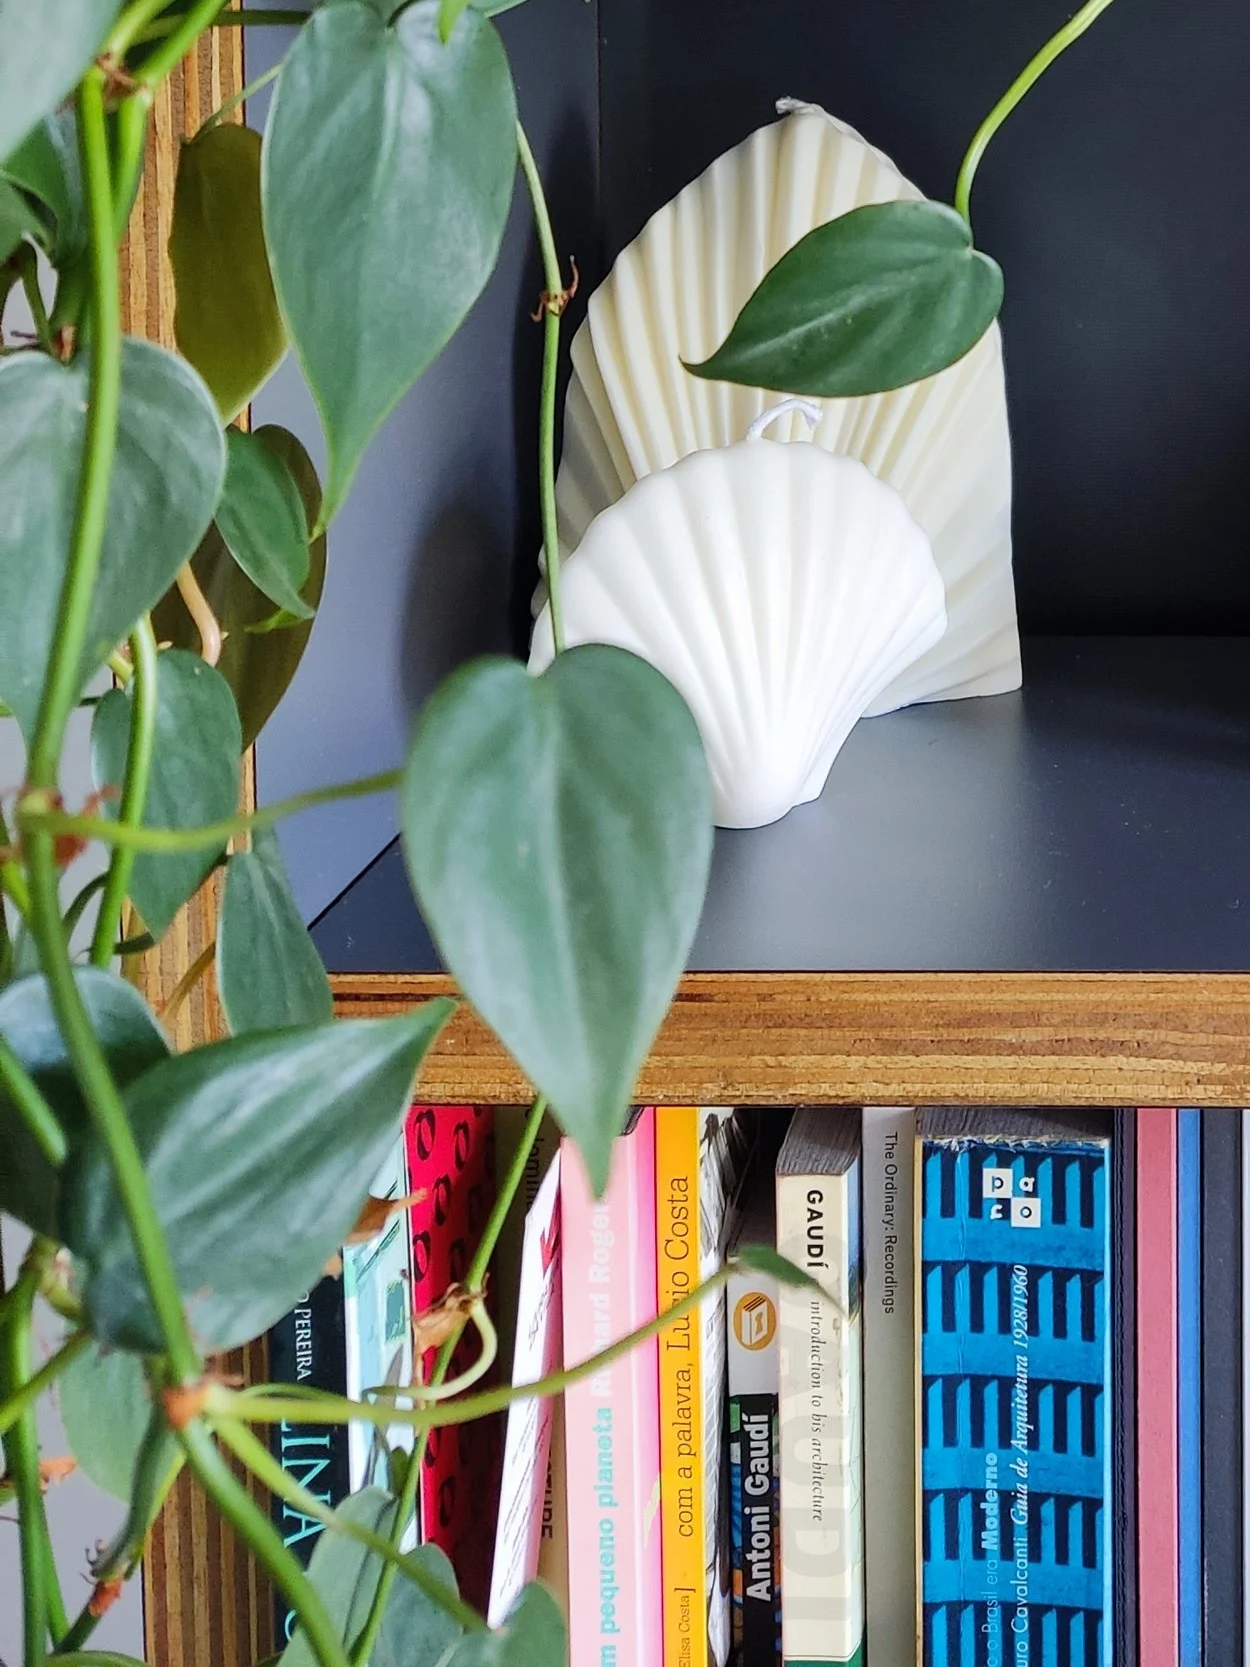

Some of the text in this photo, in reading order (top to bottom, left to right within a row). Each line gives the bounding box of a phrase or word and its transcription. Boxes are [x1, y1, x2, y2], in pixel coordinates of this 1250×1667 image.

[807, 1189, 829, 1268] GAUDÍ
[882, 1132, 898, 1315] The Ordinary: Recordings
[294, 1307, 313, 1382] PEREIRA
[810, 1300, 822, 1390] introduction
[1010, 1264, 1029, 1351] 1928/1960
[664, 1175, 698, 1537] com a palavra, Luio Costa
[811, 1393, 822, 1408] to
[1010, 1355, 1034, 1454] Arquitetura
[282, 1418, 333, 1549] INA
[592, 1406, 618, 1507] planeta
[811, 1438, 825, 1523] architecture
[980, 1452, 999, 1551] Moderno
[1010, 1456, 1029, 1479] de
[743, 1412, 772, 1601] Antoni Gaudí
[1010, 1483, 1029, 1525] Guia
[597, 1519, 619, 1636] pequeno
[981, 1592, 998, 1633] Brasil
[986, 1559, 998, 1584] era
[1010, 1537, 1029, 1633] Cavalcanti
